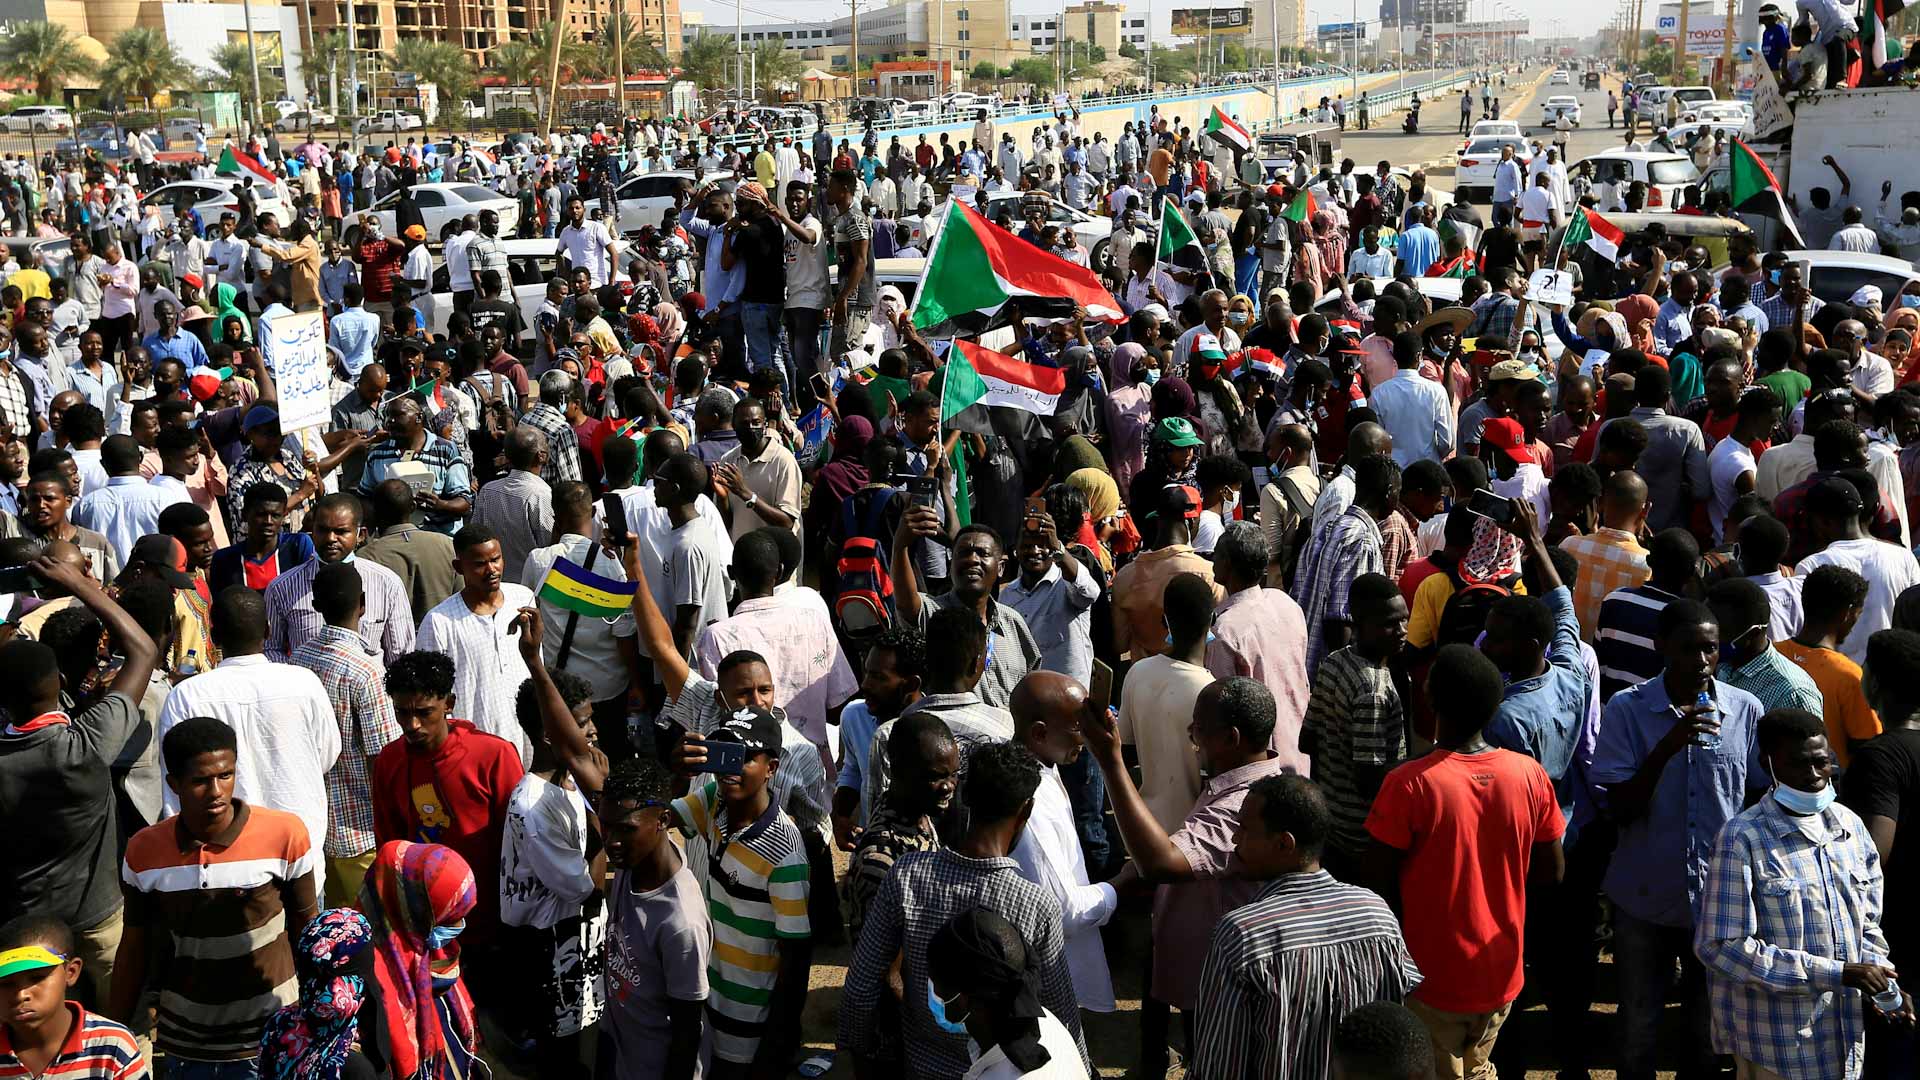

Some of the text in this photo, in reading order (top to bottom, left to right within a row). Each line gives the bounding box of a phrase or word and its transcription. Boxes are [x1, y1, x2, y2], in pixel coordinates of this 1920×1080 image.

[280, 318, 321, 346] تكوين
[298, 347, 321, 375] المجلس
[284, 375, 326, 400] مطلب ثوري
[725, 720, 752, 729] adidas
